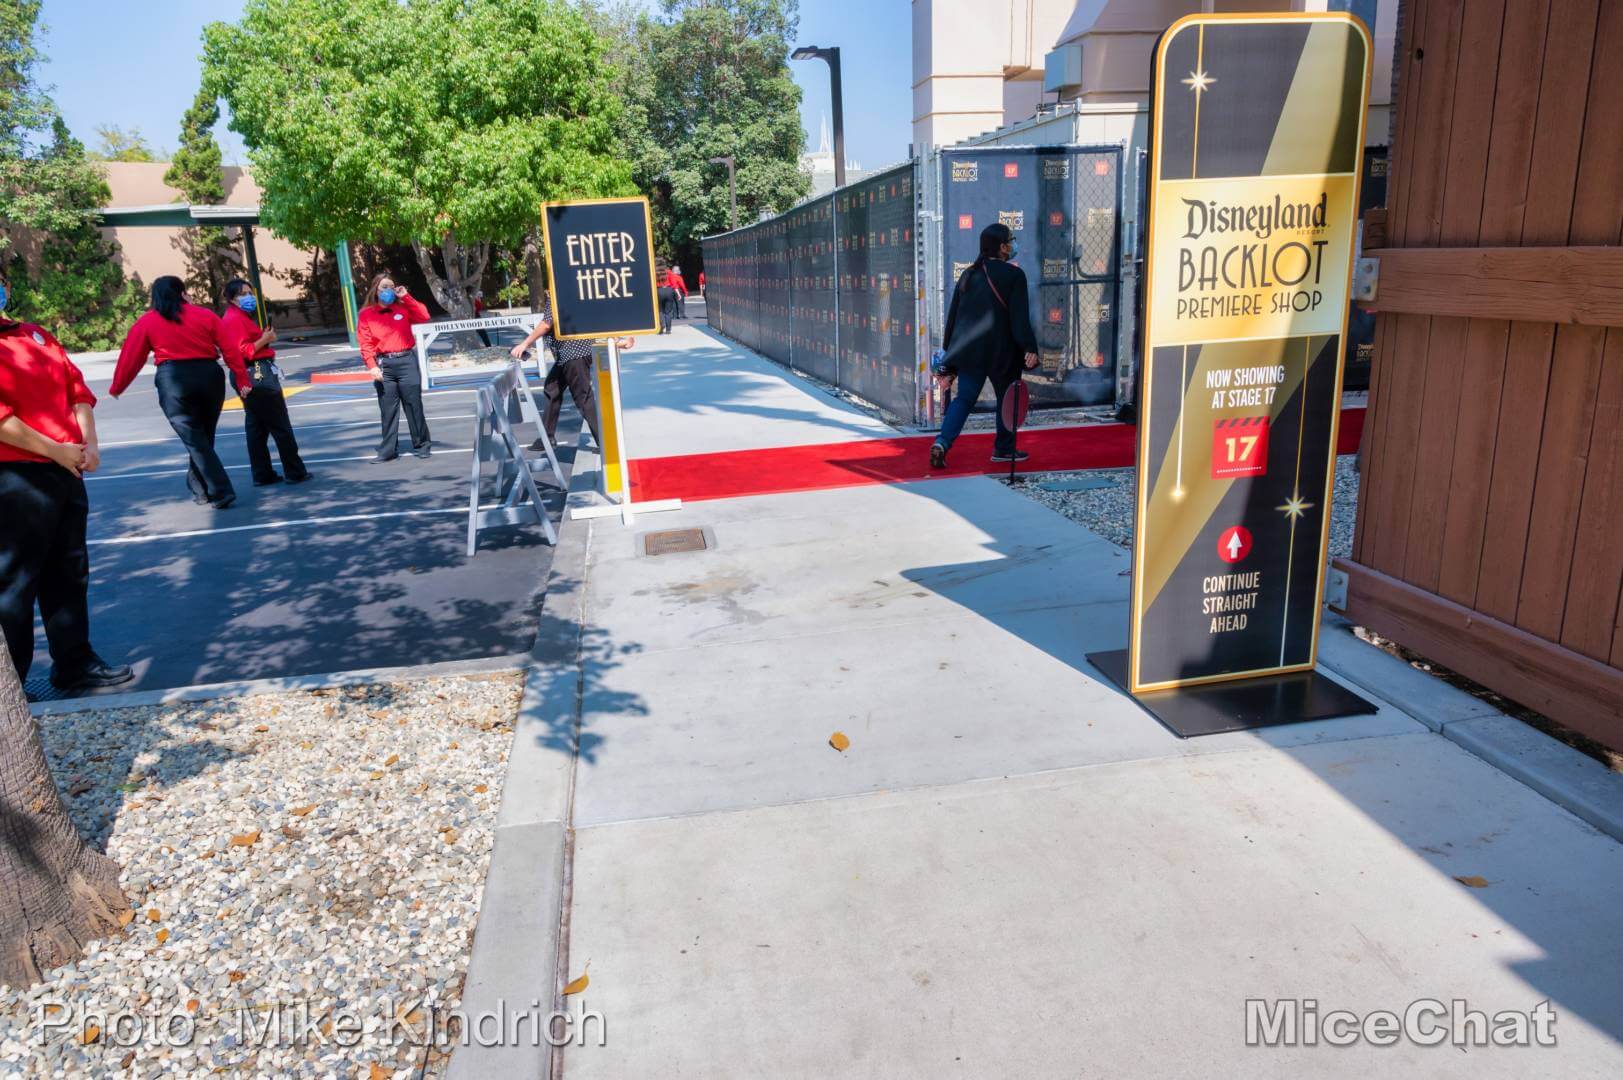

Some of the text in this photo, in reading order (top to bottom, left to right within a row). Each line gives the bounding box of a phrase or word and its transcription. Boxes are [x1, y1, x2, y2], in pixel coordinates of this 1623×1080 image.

[1181, 192, 1328, 240] Disneyland
[566, 232, 635, 266] ENTER
[1178, 240, 1328, 292] BACKLOT
[576, 267, 634, 301] HERE
[1177, 290, 1322, 320] PREMIERE SHOP
[434, 317, 522, 332] HOLLYWOOD BACK LOT
[1206, 365, 1285, 389] NOW SHOWING
[1211, 387, 1277, 409] AT STAGE 17
[1225, 435, 1259, 463] 17
[1203, 571, 1261, 594] CONTINUE
[1202, 592, 1259, 615] STRAIGHT
[1209, 614, 1248, 634] AHEAD
